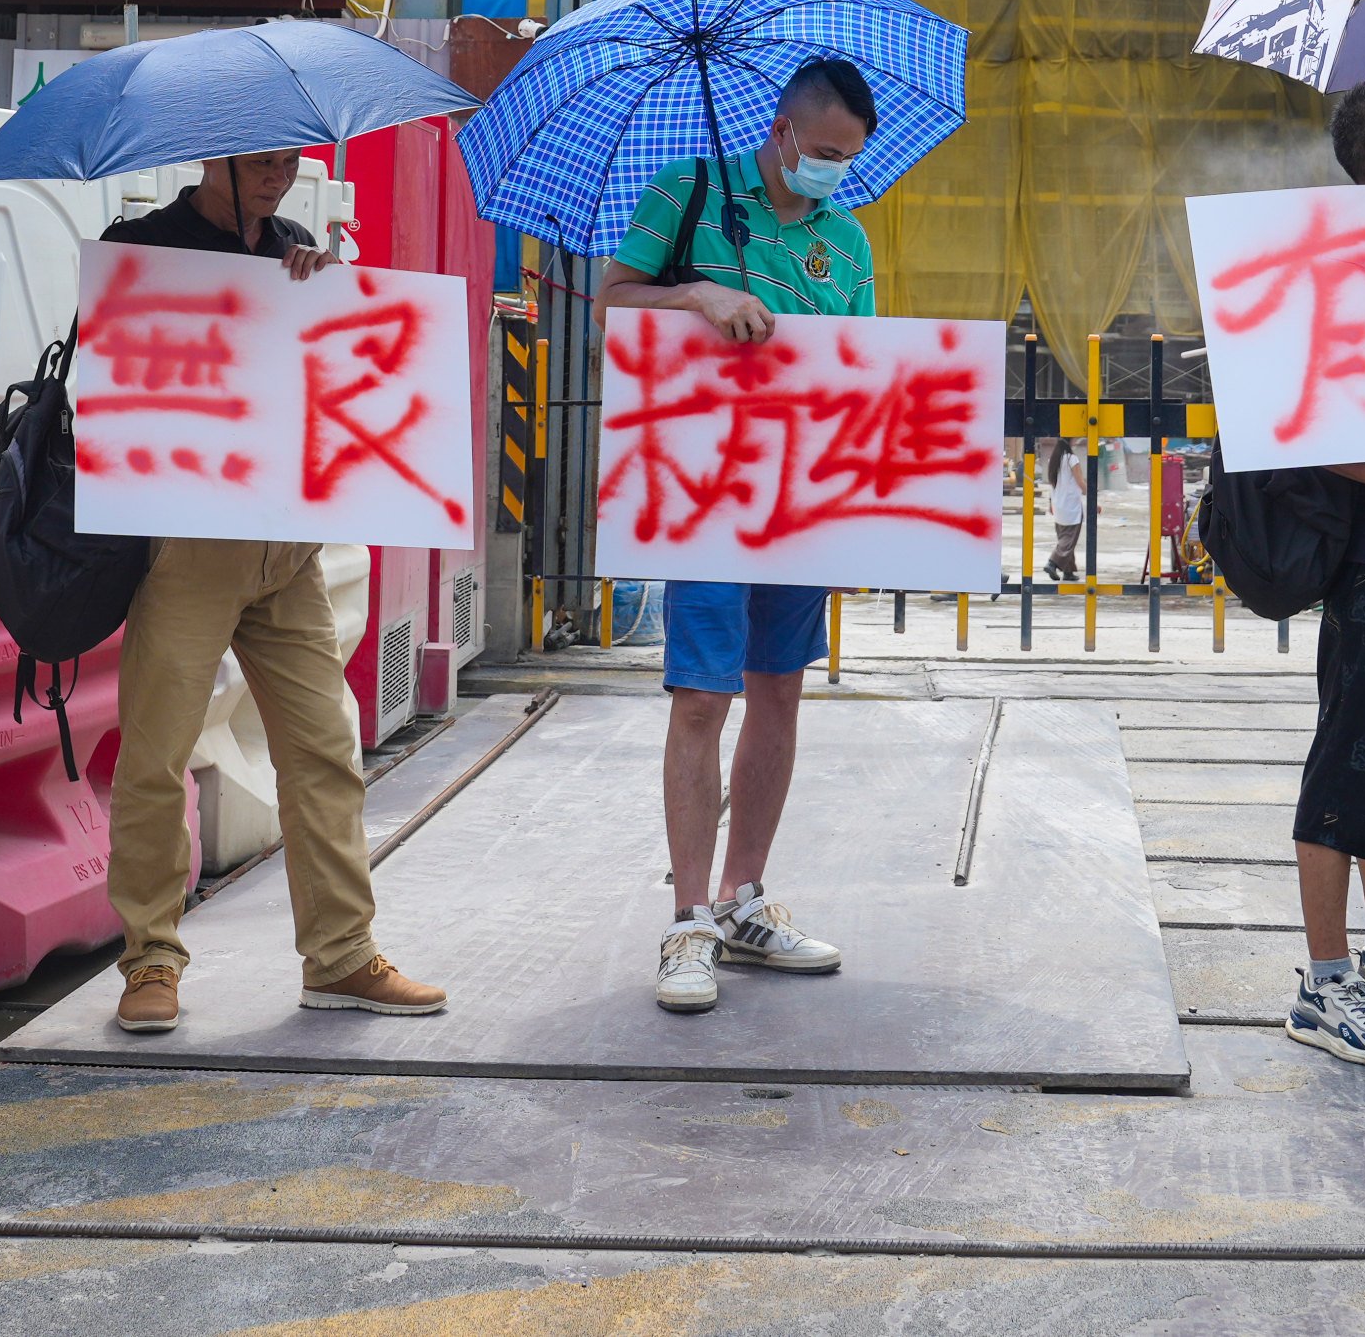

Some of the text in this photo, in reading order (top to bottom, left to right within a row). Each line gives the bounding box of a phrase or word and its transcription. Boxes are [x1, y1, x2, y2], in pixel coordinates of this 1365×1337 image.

[76, 254, 467, 526] 無良
[597, 310, 994, 550] 精進
[88, 856, 105, 875] EN
